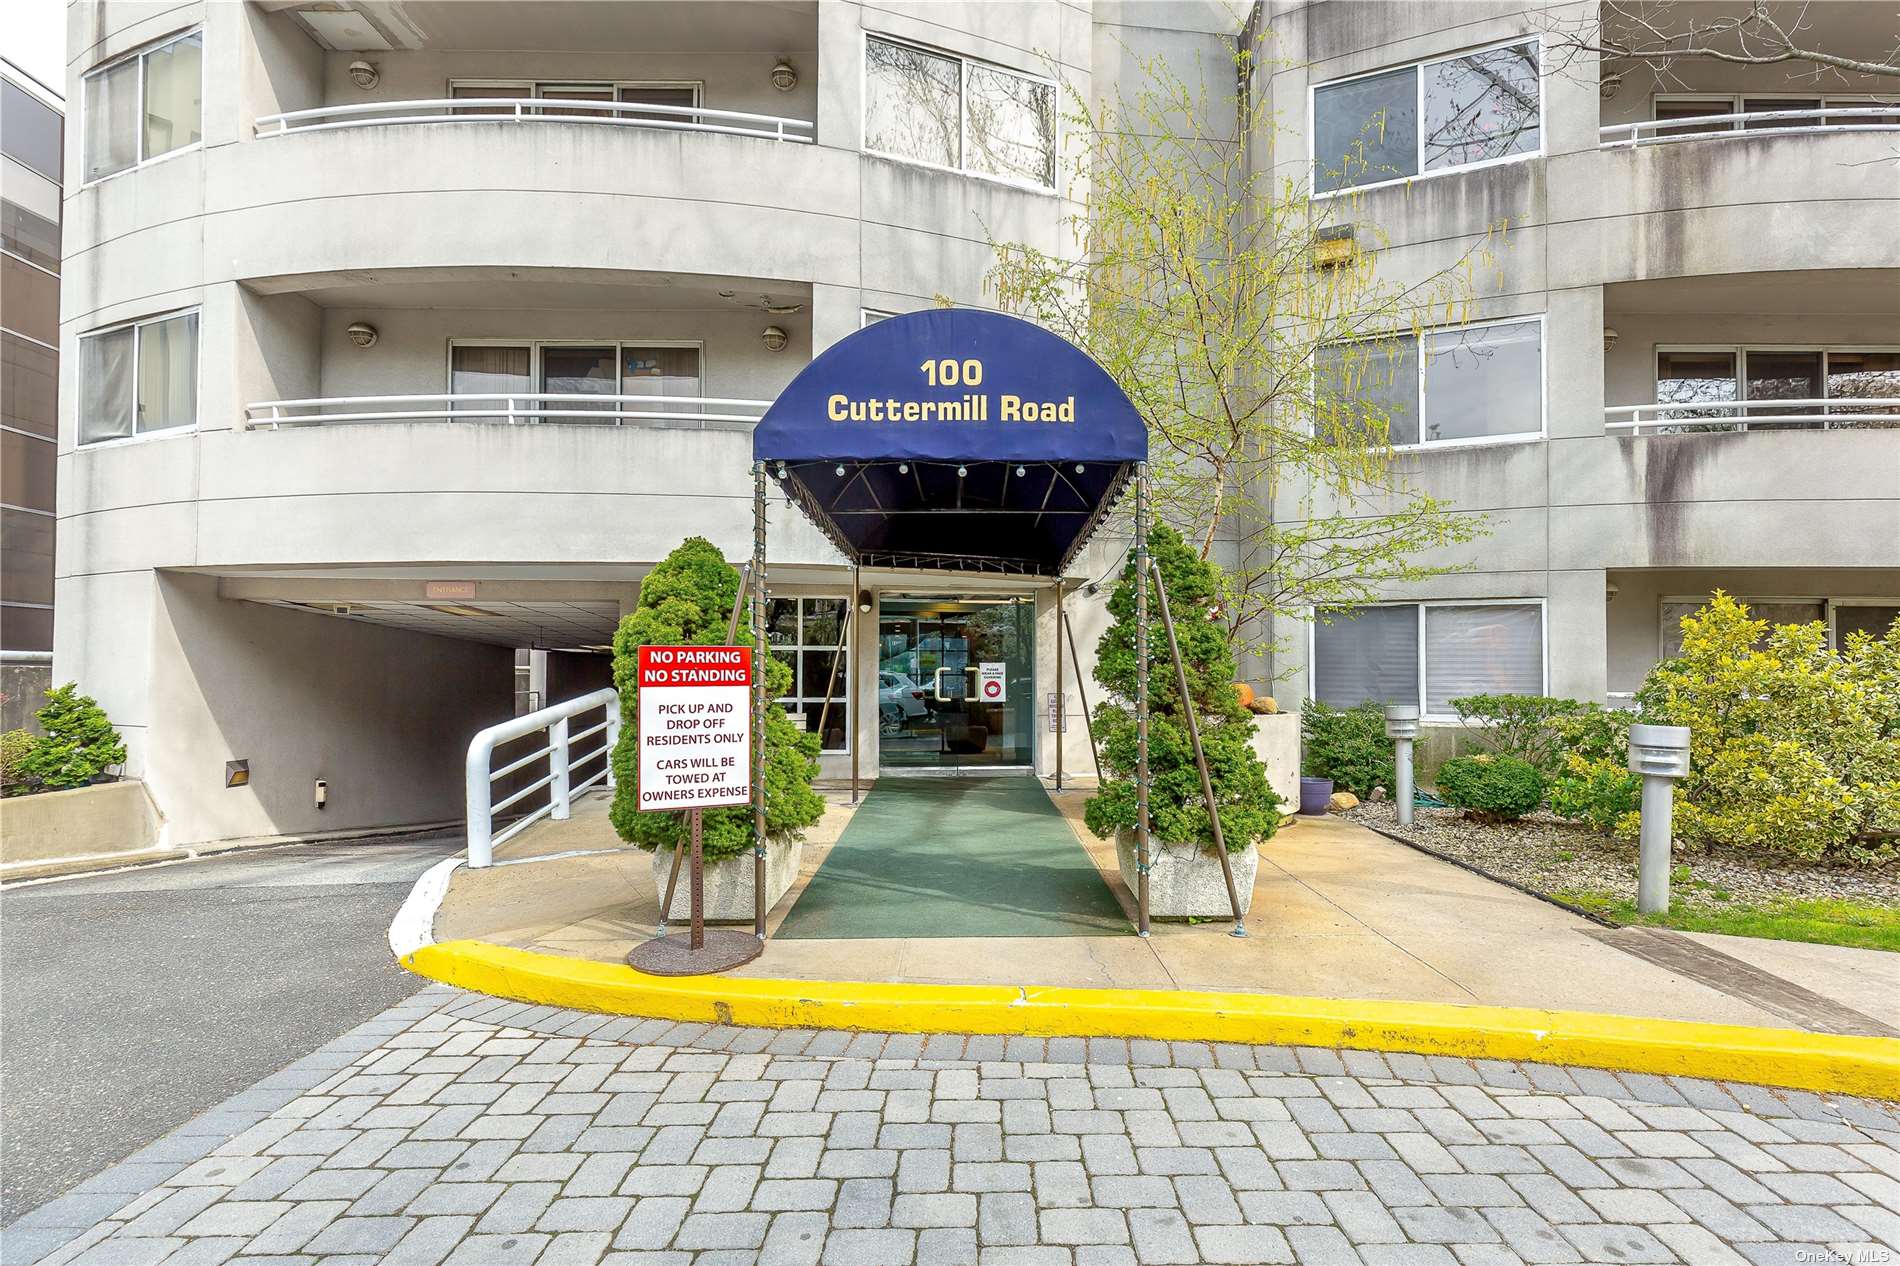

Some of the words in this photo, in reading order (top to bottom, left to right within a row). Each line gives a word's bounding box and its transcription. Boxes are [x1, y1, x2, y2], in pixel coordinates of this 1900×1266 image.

[920, 359, 983, 386] 100
[828, 394, 987, 422] Cuttermill
[1000, 395, 1075, 422] Road
[651, 651, 674, 663] NO
[677, 651, 741, 663] PARKING
[645, 670, 668, 682] NO
[671, 669, 746, 682] STANDING
[658, 704, 686, 714] PICK
[689, 703, 705, 714] UP
[707, 703, 733, 713] AND
[667, 719, 700, 730] DROP
[703, 718, 726, 729] OFF
[647, 734, 711, 746] RESIDENTS
[713, 733, 744, 743] ONLY
[656, 759, 687, 770] CARS
[690, 758, 718, 768] WILL
[721, 757, 735, 767] BE
[666, 773, 709, 785] TOWED
[712, 772, 726, 783] AT
[642, 789, 695, 802] OWNERS
[697, 786, 748, 798] EXPENSE
